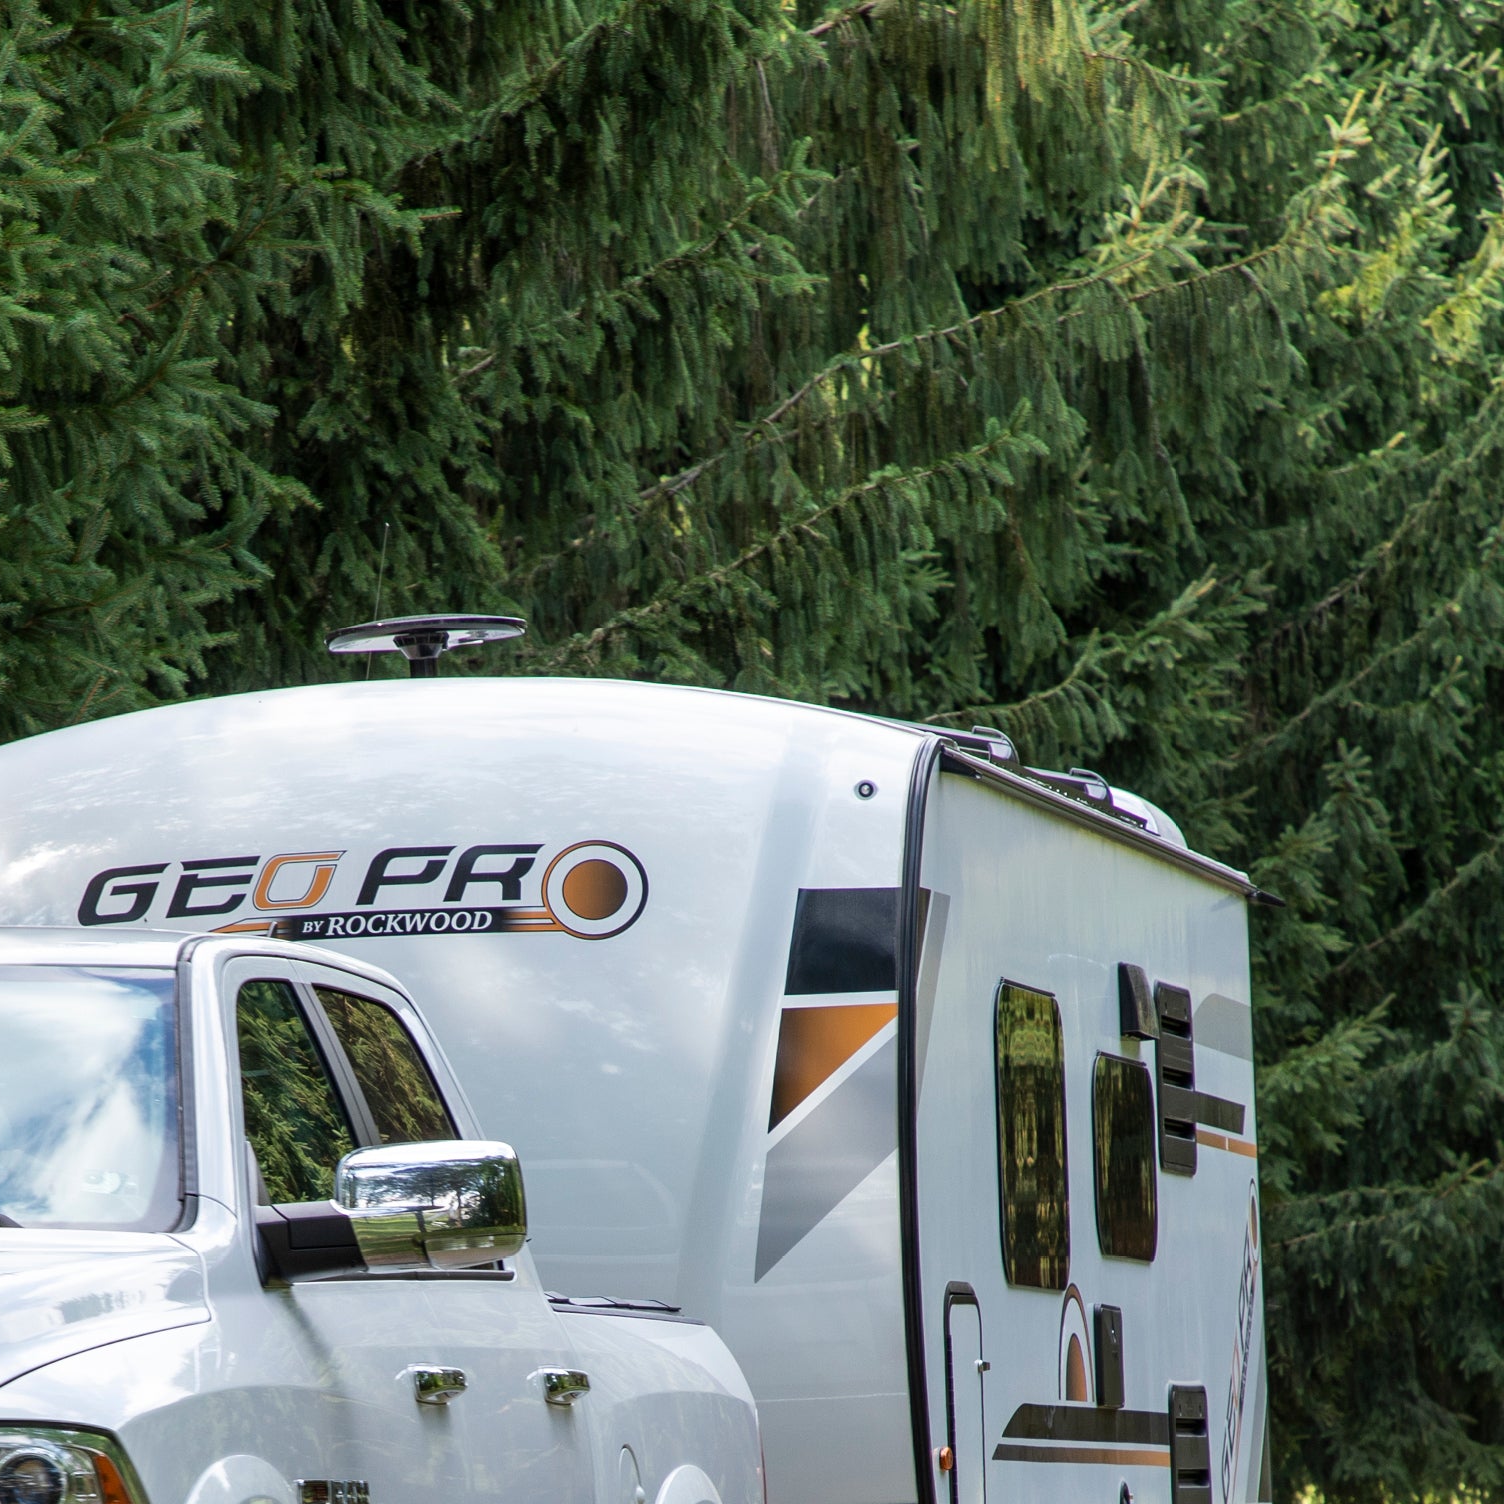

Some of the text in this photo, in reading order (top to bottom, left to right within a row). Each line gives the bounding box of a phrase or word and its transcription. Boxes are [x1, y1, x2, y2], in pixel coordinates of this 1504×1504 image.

[77, 839, 649, 940] GEO PRO
[302, 911, 492, 936] BY ROCKWOOD
